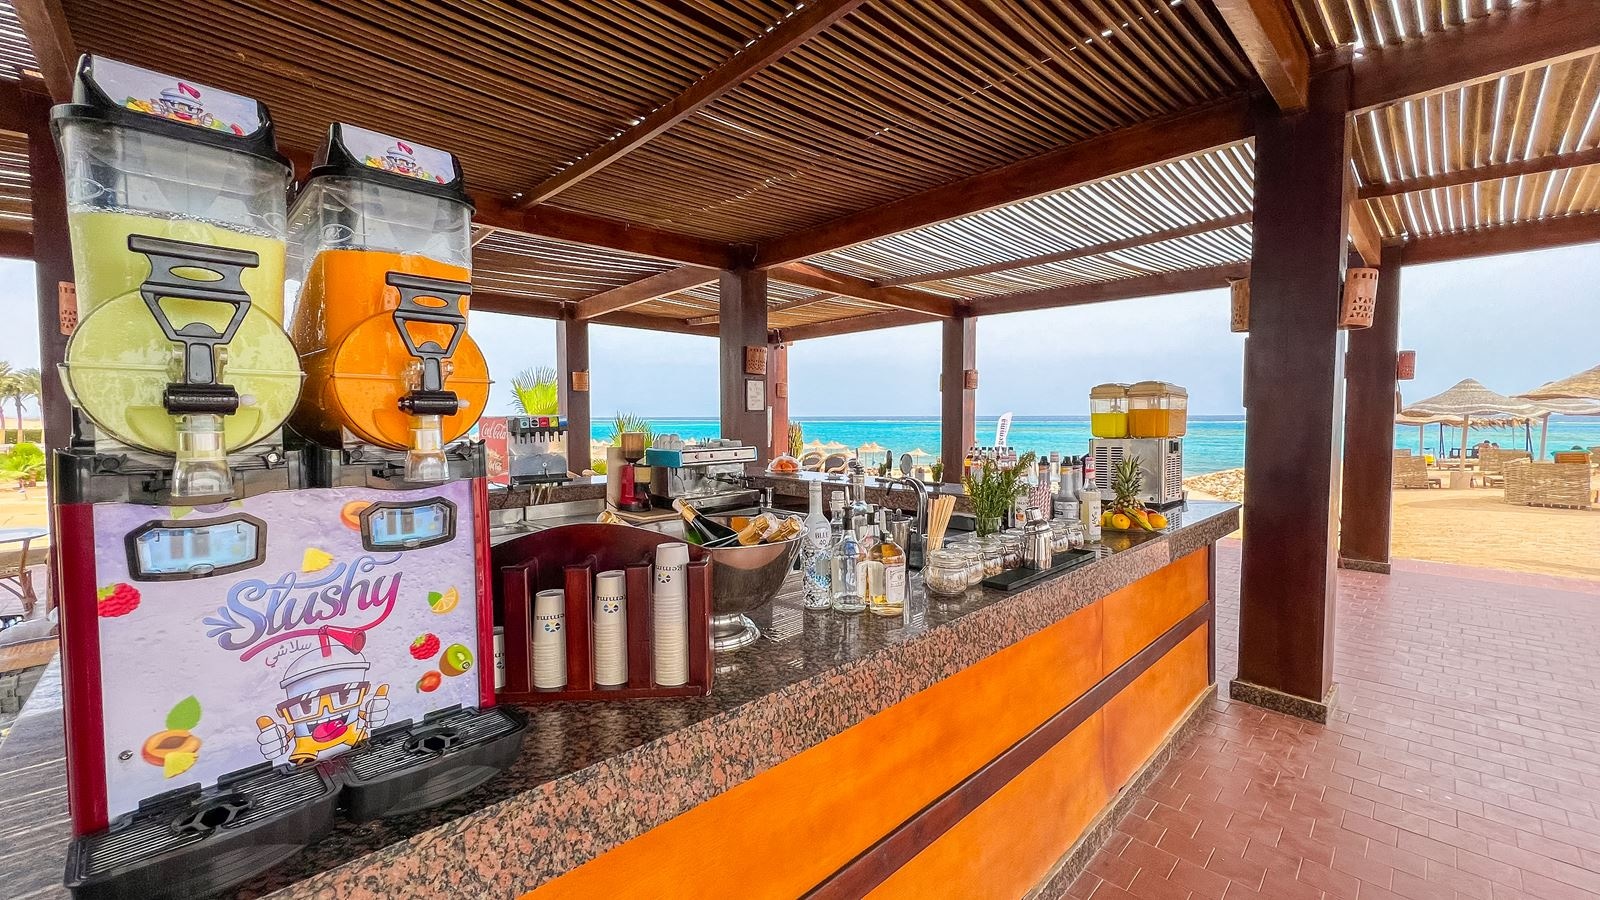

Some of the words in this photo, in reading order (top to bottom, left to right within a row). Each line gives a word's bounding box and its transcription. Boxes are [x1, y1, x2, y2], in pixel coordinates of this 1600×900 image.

[998, 418, 1007, 446] gemma
[656, 563, 683, 573] gemm
[215, 552, 403, 652] Slushy
